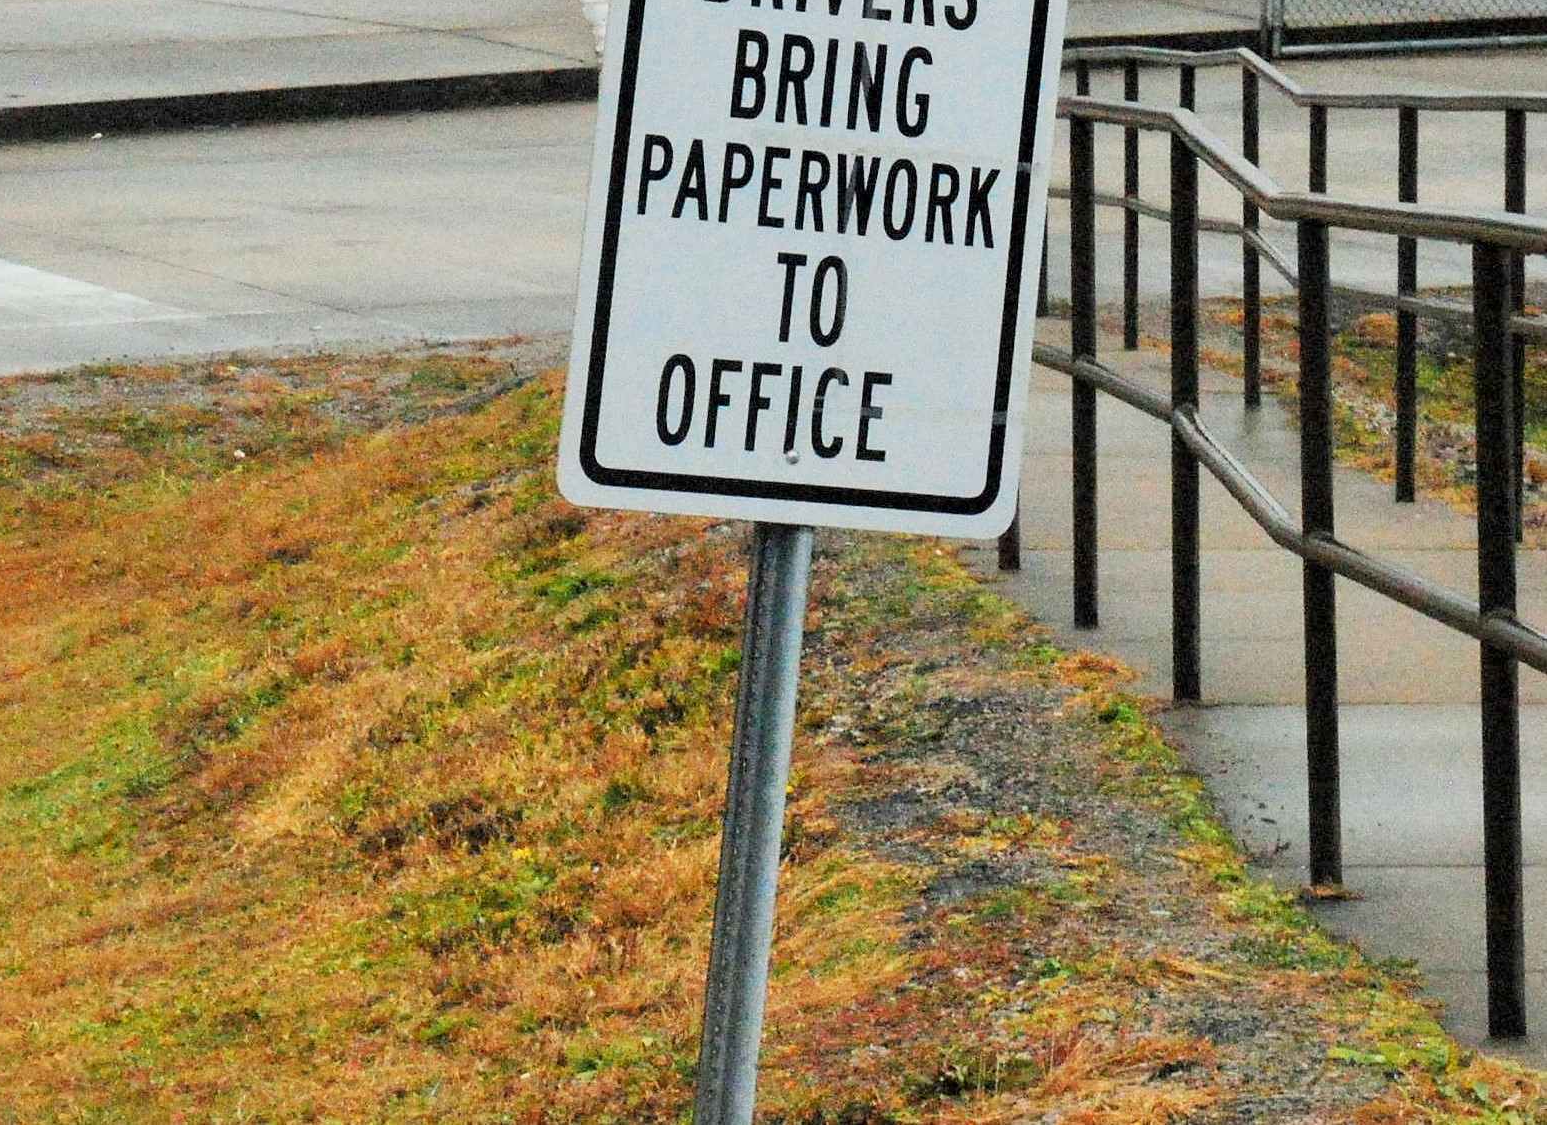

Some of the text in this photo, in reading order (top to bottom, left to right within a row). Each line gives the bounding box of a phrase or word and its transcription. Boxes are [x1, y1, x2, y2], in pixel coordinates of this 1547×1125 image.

[729, 28, 934, 139] BRING
[636, 133, 1001, 249] PAPERWORK
[777, 251, 848, 348] TO
[656, 353, 893, 463] OFFICE
